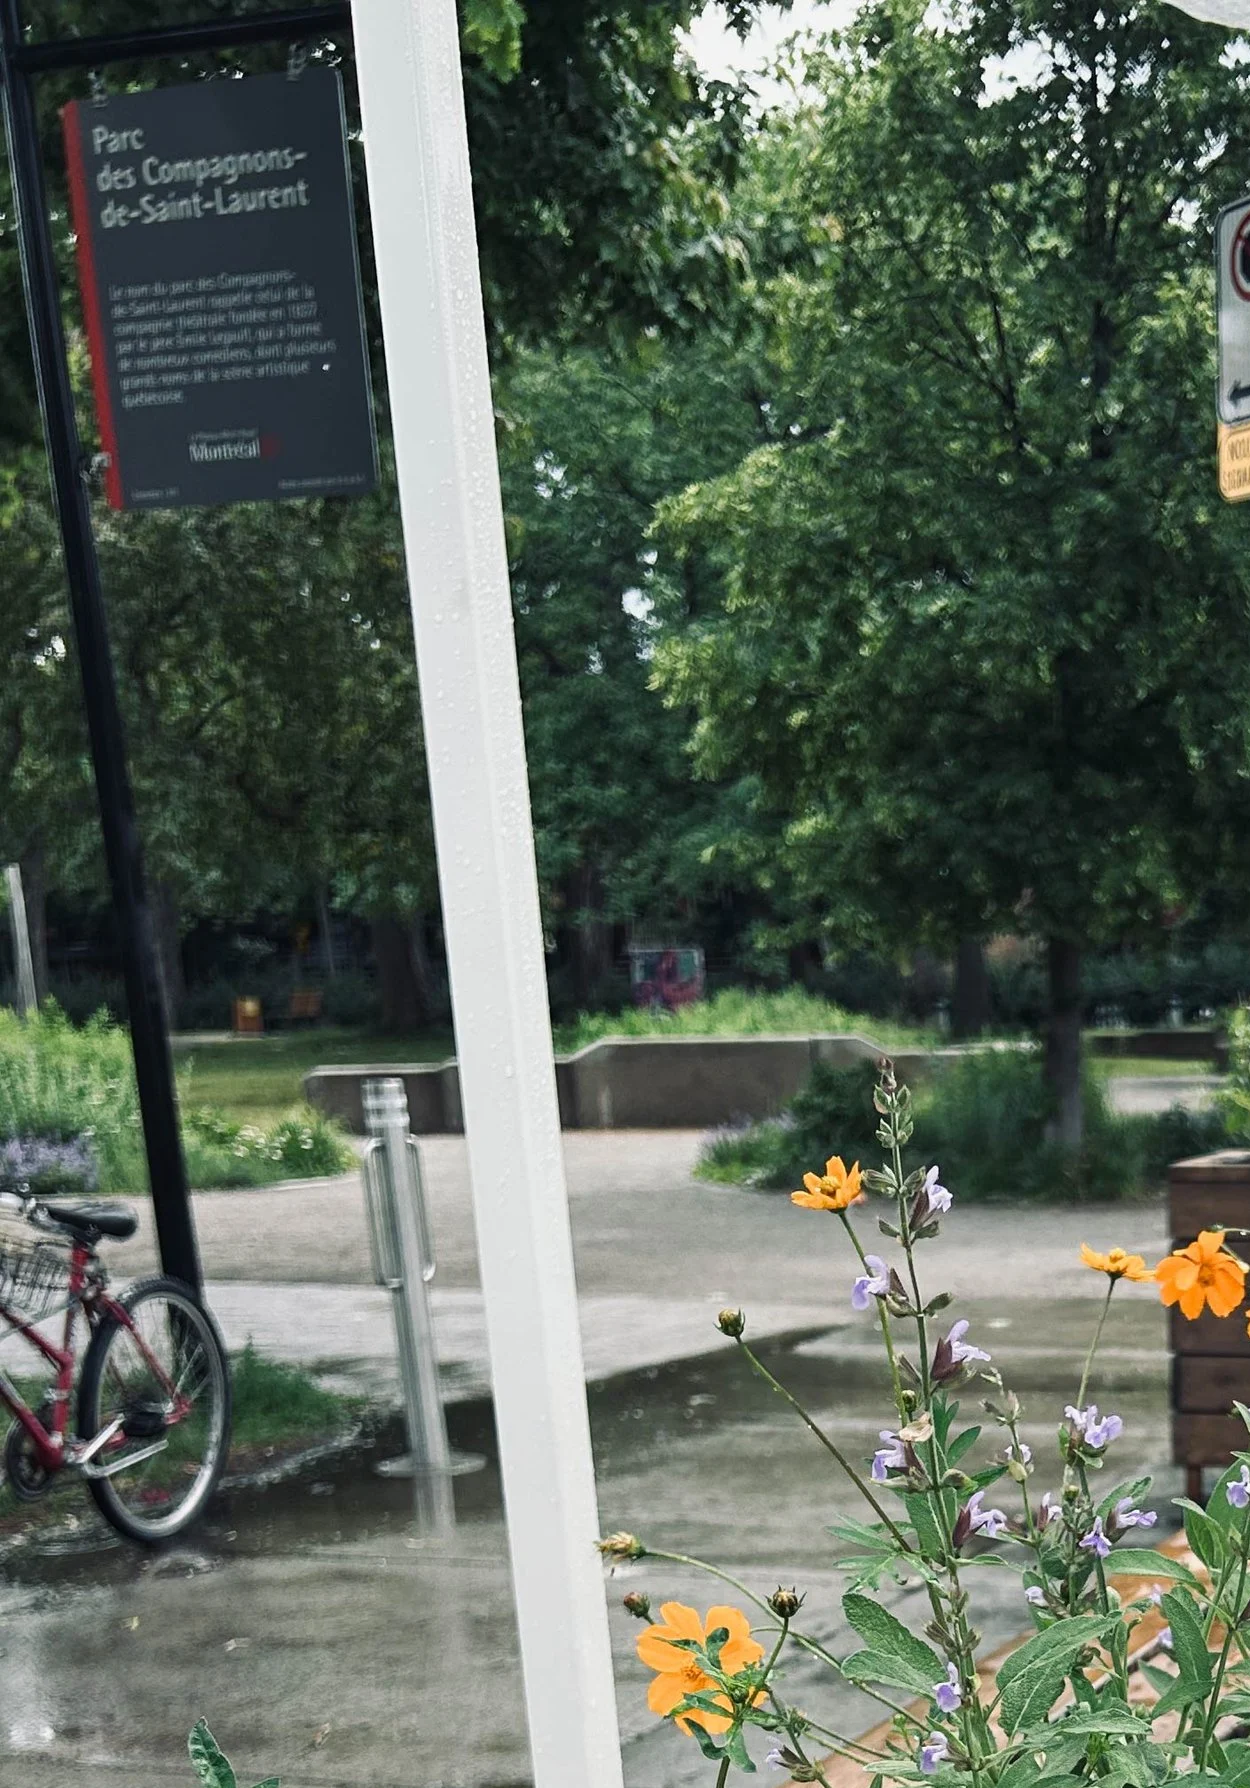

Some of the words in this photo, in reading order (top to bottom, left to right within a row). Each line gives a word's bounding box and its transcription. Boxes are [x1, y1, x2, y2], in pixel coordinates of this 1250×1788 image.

[92, 124, 146, 155] Parc
[96, 162, 138, 193] des
[142, 146, 309, 186] Compagnons-
[100, 180, 310, 229] de-Saint-Laurent
